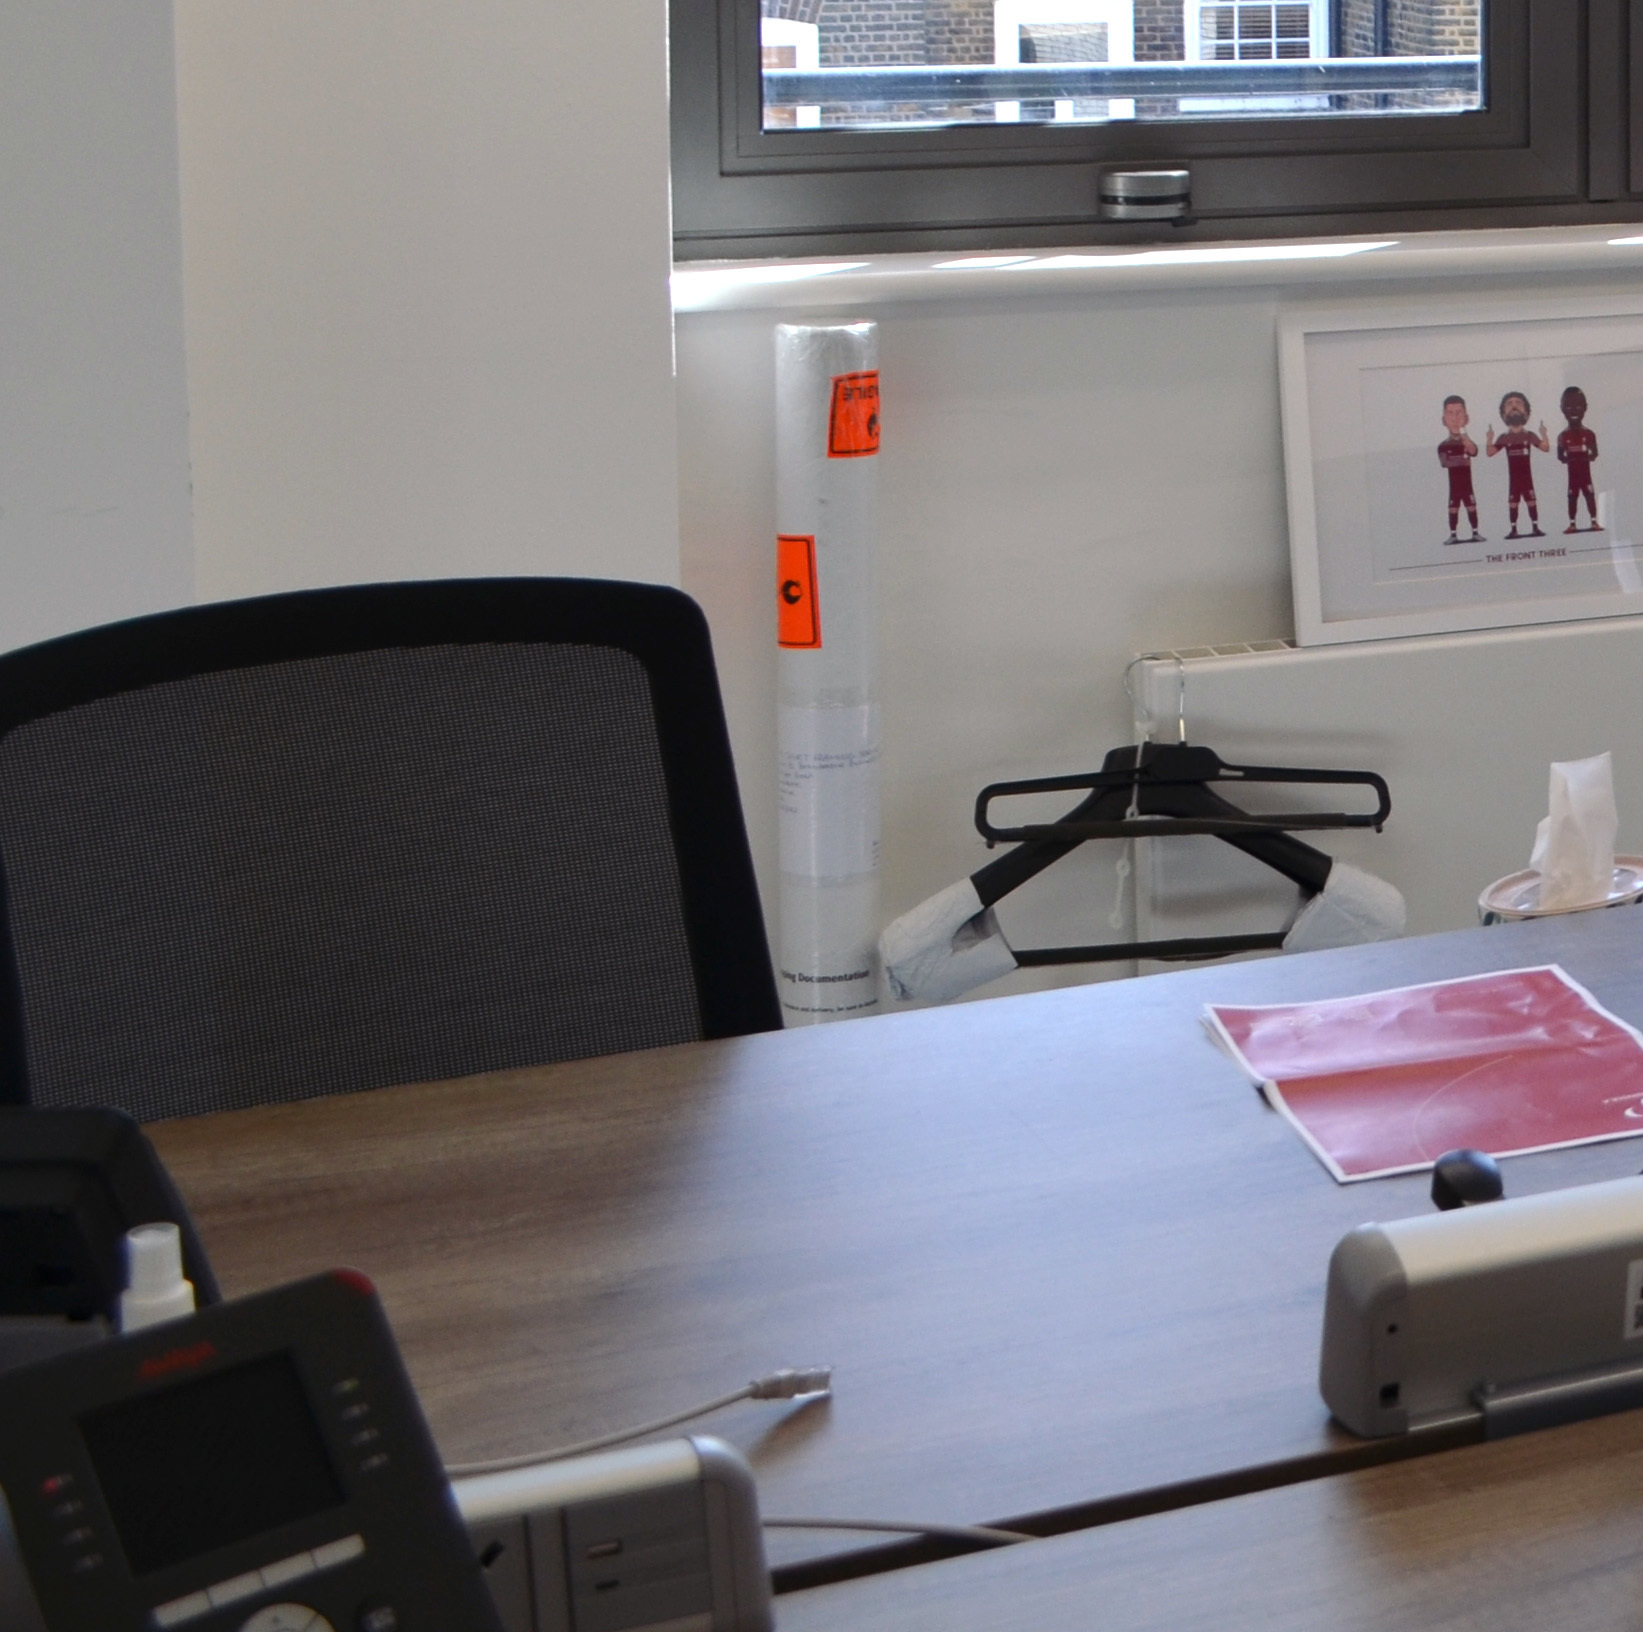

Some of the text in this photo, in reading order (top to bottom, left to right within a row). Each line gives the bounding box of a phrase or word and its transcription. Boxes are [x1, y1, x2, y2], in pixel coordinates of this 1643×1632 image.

[1486, 548, 1567, 563] THE FRONT THREE
[798, 969, 869, 983] Documentation
